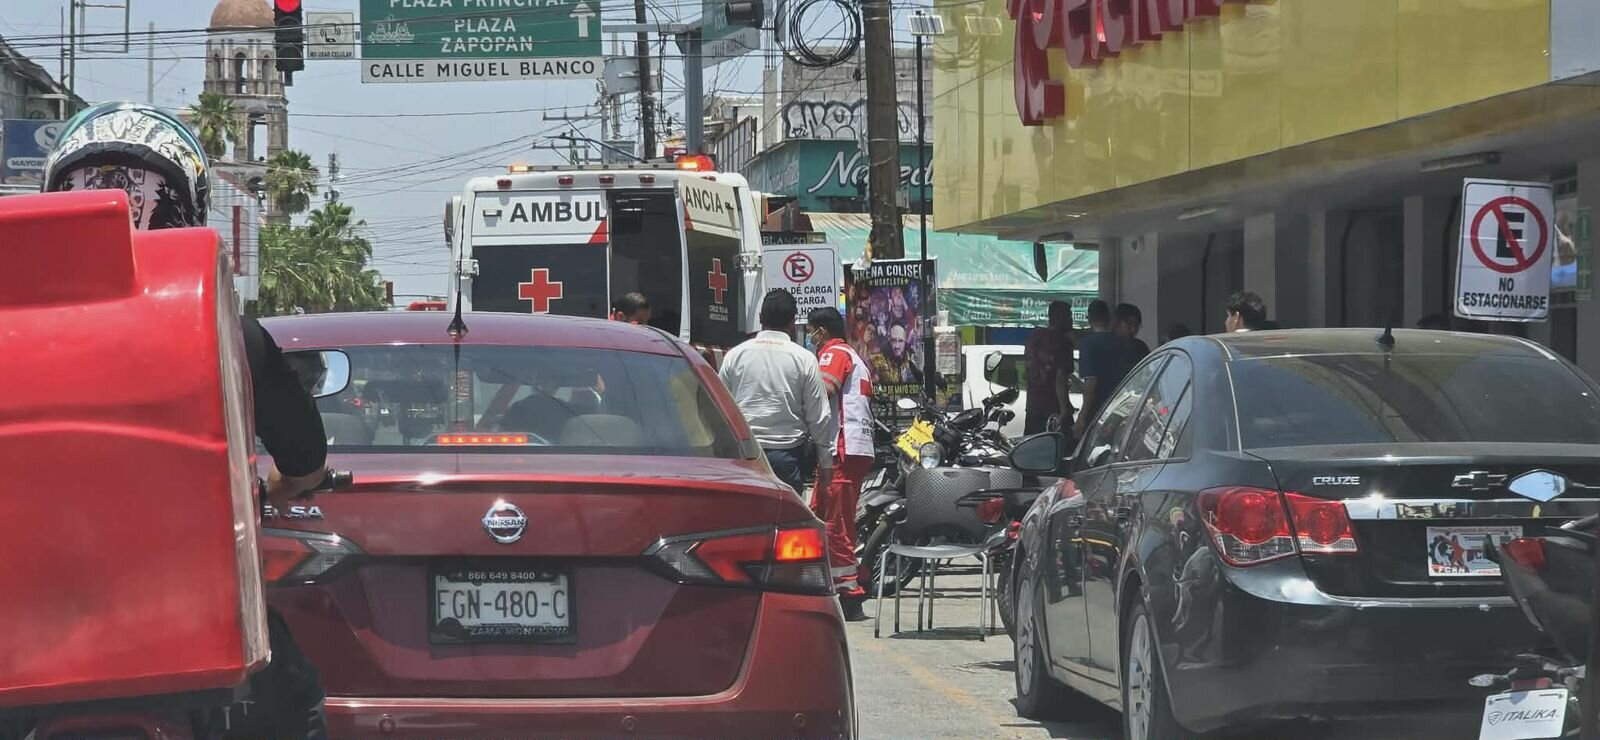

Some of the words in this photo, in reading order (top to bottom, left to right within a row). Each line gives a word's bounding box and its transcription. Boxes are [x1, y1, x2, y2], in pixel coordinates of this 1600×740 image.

[454, 17, 516, 33] PLAZA
[441, 36, 533, 53] ZAPOPAN
[370, 63, 424, 78] CALLE
[437, 62, 509, 77] MIGUEL
[520, 60, 595, 76] BLANCO
[509, 202, 606, 223] AMBUL
[790, 286, 802, 295] DE
[804, 285, 832, 294] CARGA
[1498, 278, 1515, 291] NO
[1463, 292, 1547, 310] ESTACIONARSE
[1312, 476, 1361, 486] CRUZE
[488, 518, 524, 526] NISSAN
[468, 572, 487, 580] 866
[489, 572, 508, 580] 649
[511, 572, 536, 580] 8400
[437, 589, 566, 619] FGN-480-C
[1502, 709, 1557, 721] ITALIKA
